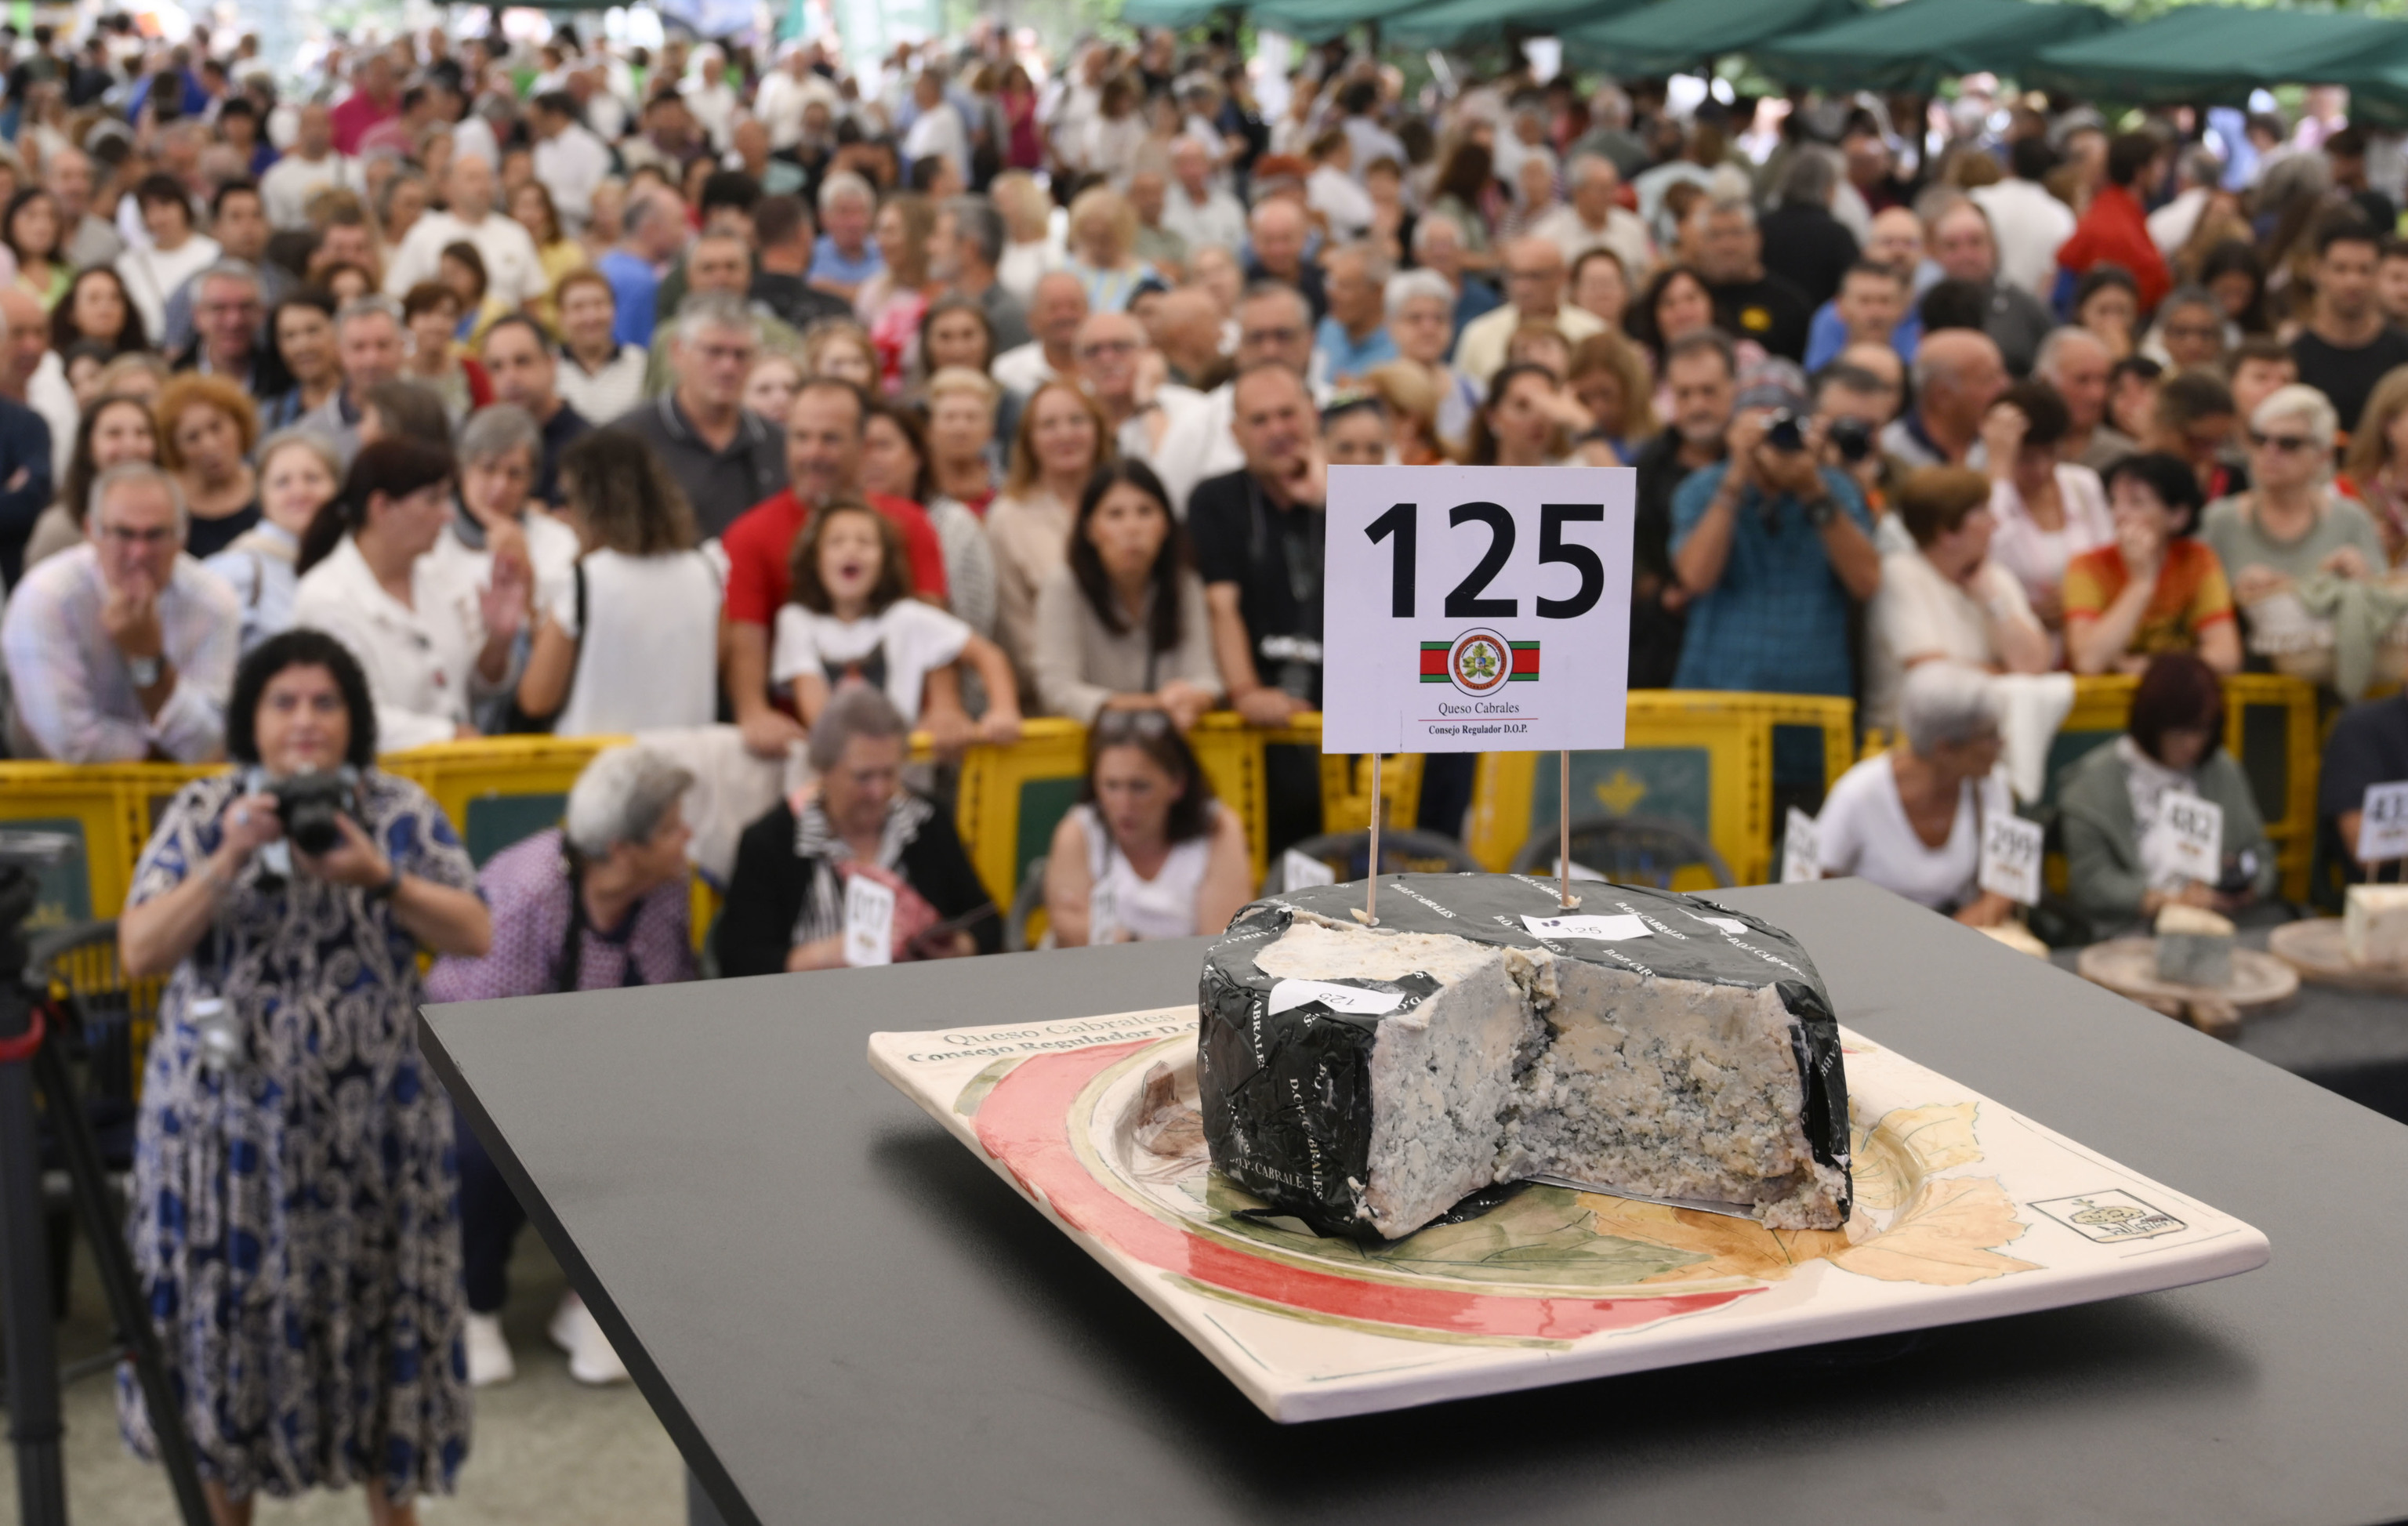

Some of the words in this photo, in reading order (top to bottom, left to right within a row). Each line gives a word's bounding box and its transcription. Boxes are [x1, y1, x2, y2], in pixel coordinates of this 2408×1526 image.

[1364, 501, 1605, 619] 125
[1438, 702, 1471, 716] Queso
[1474, 701, 1520, 714] Cabrales
[1429, 725, 1460, 736] Consejo
[1462, 724, 1502, 736] Regulador
[1503, 723, 1528, 734] D.O.P.
[1389, 883, 1412, 896] D.O.P.
[1412, 893, 1457, 919] CABRALES
[1532, 883, 1562, 901] CABRA
[1602, 948, 1631, 963] D.O.P.
[1319, 992, 1355, 1006] 125
[907, 1046, 1014, 1063] Consejo
[1017, 1030, 1152, 1050] Regulador
[1158, 1021, 1199, 1035] D.O
[943, 1030, 1040, 1046] Queso
[1046, 1013, 1177, 1035] Cabrales
[1253, 993, 1265, 1069] ABRALE
[1301, 1121, 1323, 1200] CBRALES
[1255, 1162, 1309, 1190] CABRALE
